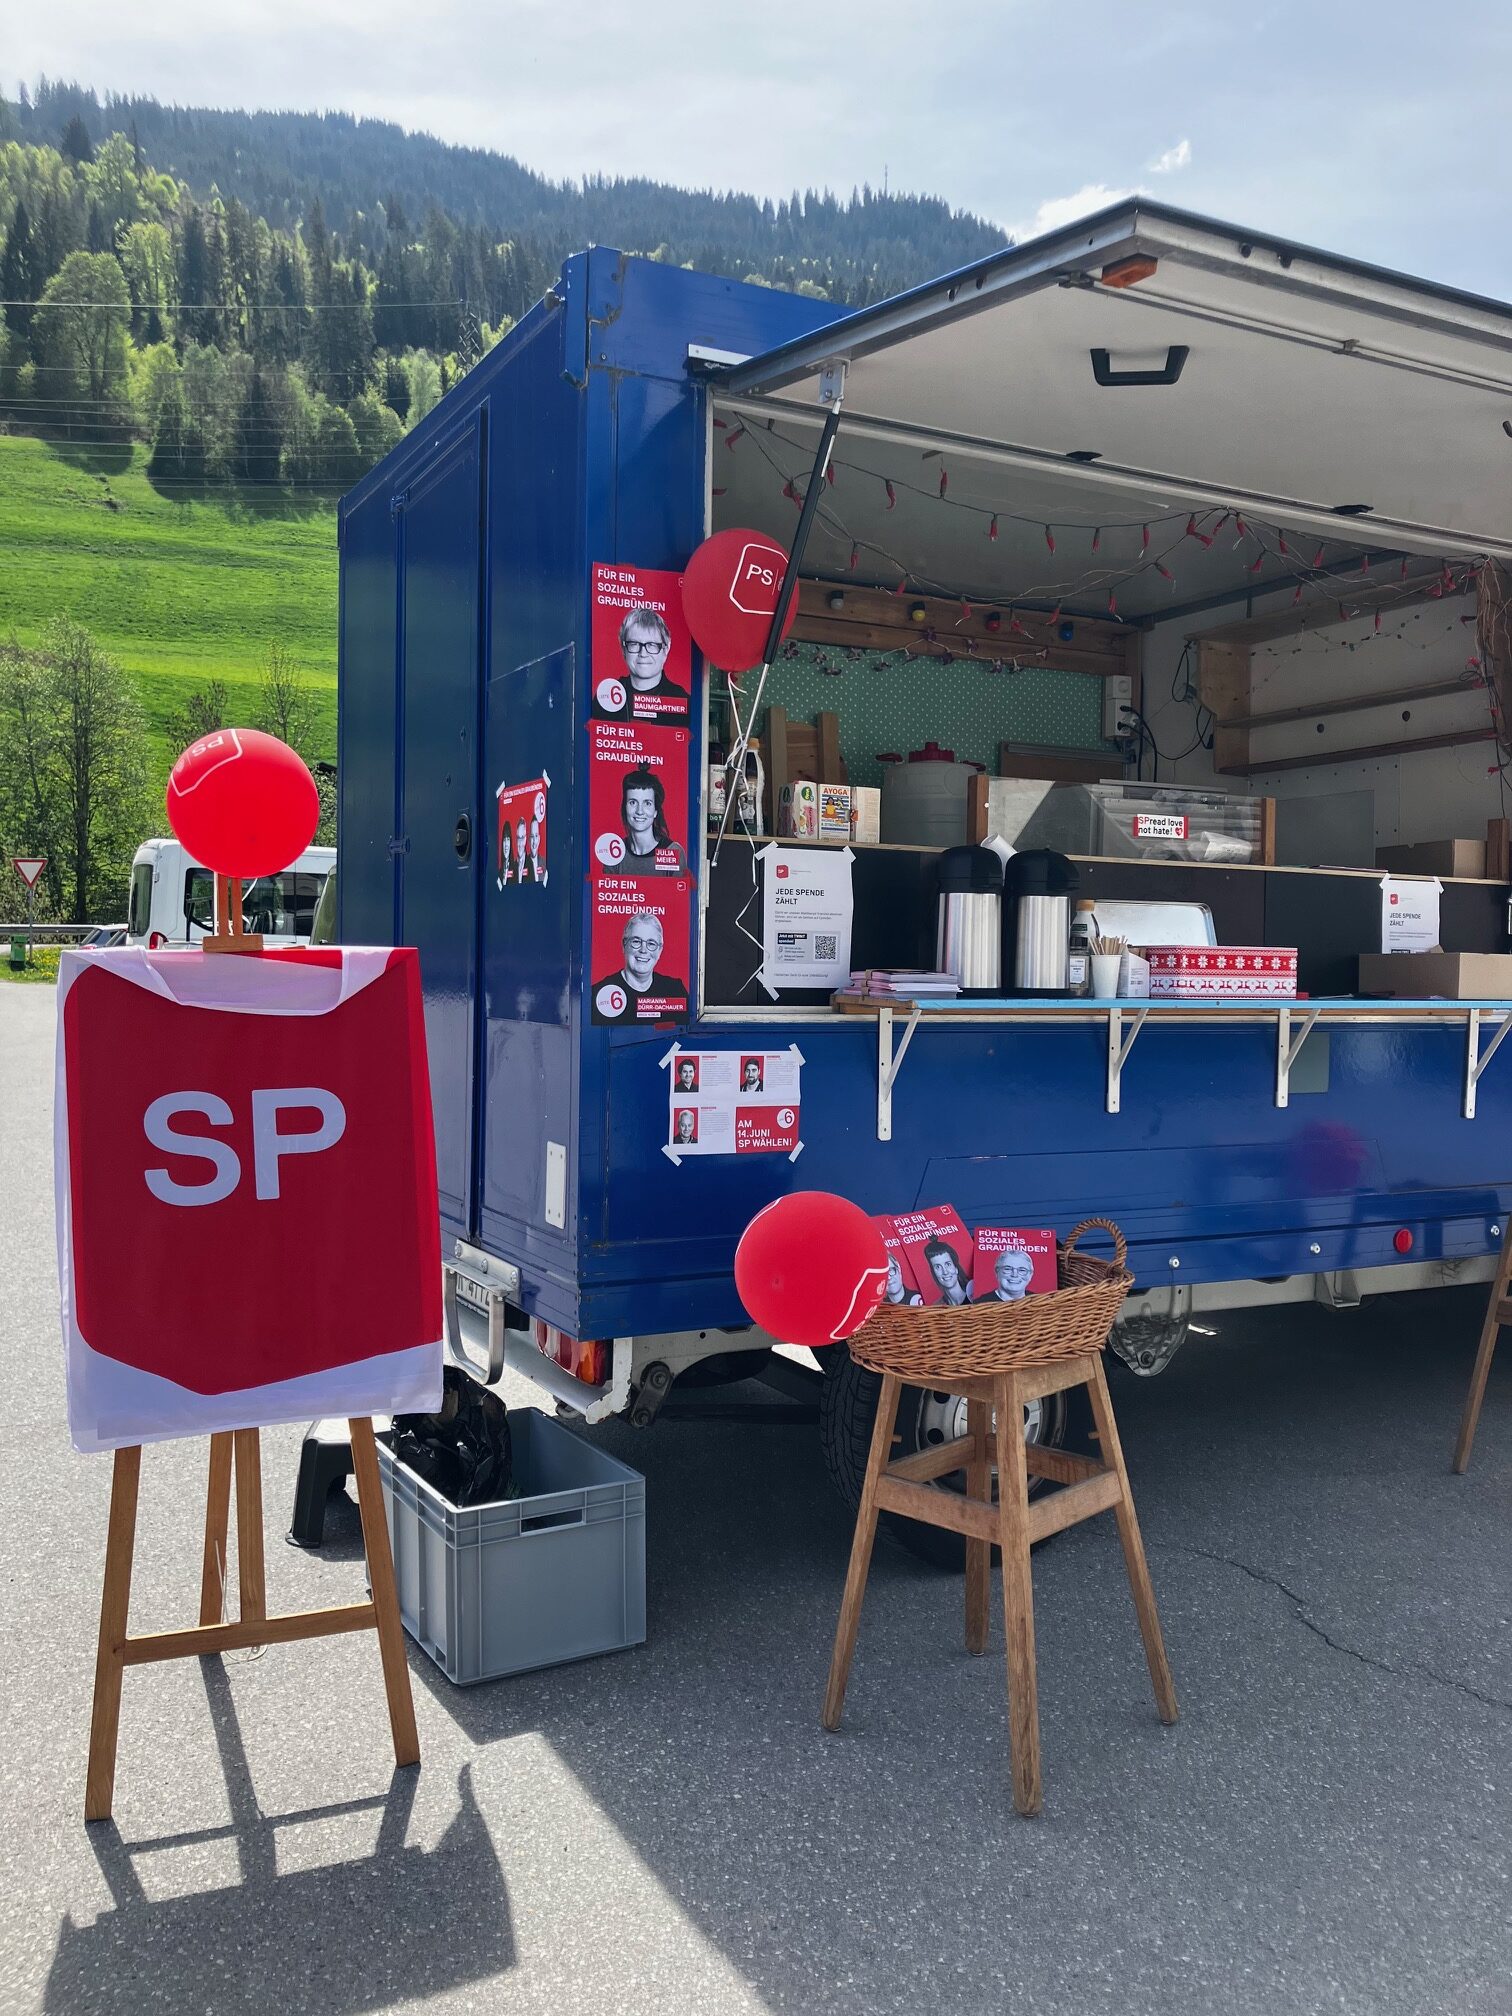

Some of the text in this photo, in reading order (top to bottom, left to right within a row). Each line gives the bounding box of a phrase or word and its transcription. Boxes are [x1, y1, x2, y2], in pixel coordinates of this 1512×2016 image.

[597, 568, 635, 583] FÜR EIN
[746, 564, 774, 586] PS
[597, 582, 644, 597] SOZIALES
[597, 595, 666, 611] GRAUBÜNDEN
[610, 685, 623, 705] 6
[634, 695, 662, 704] MONIKA
[634, 702, 686, 713] BAUMGARTNER
[596, 725, 635, 738] FÜR EIN
[192, 735, 224, 757] PS
[596, 739, 643, 751] SOZIALES
[596, 751, 664, 766] GRAUBÜNDEN
[823, 787, 848, 796] AYOGA
[1138, 816, 1183, 827] SPread love
[1138, 826, 1173, 835] not hate!
[609, 839, 622, 858] 6
[656, 856, 677, 864] MEIER
[598, 878, 637, 890] FÜR EIN
[598, 892, 645, 903] SOZIALES
[775, 888, 825, 897] JEDE SPENDE
[775, 896, 798, 905] ZÄHLT
[598, 903, 666, 915] GRAUBÜNDEN
[610, 990, 623, 1010] 6
[638, 1003, 684, 1011] DÜRR-DACHAUER
[784, 1110, 792, 1124] 6
[738, 1120, 752, 1128] AM
[143, 1087, 347, 1207] SP
[738, 1136, 793, 1148] SP WÄHLEN!
[893, 1214, 926, 1228] FÜR EIN
[898, 1220, 937, 1236] SOZIALES
[978, 1229, 999, 1237] FÜR
[978, 1237, 1026, 1245] SOZIALES
[978, 1243, 1048, 1253] GRAUBÜNDEN
